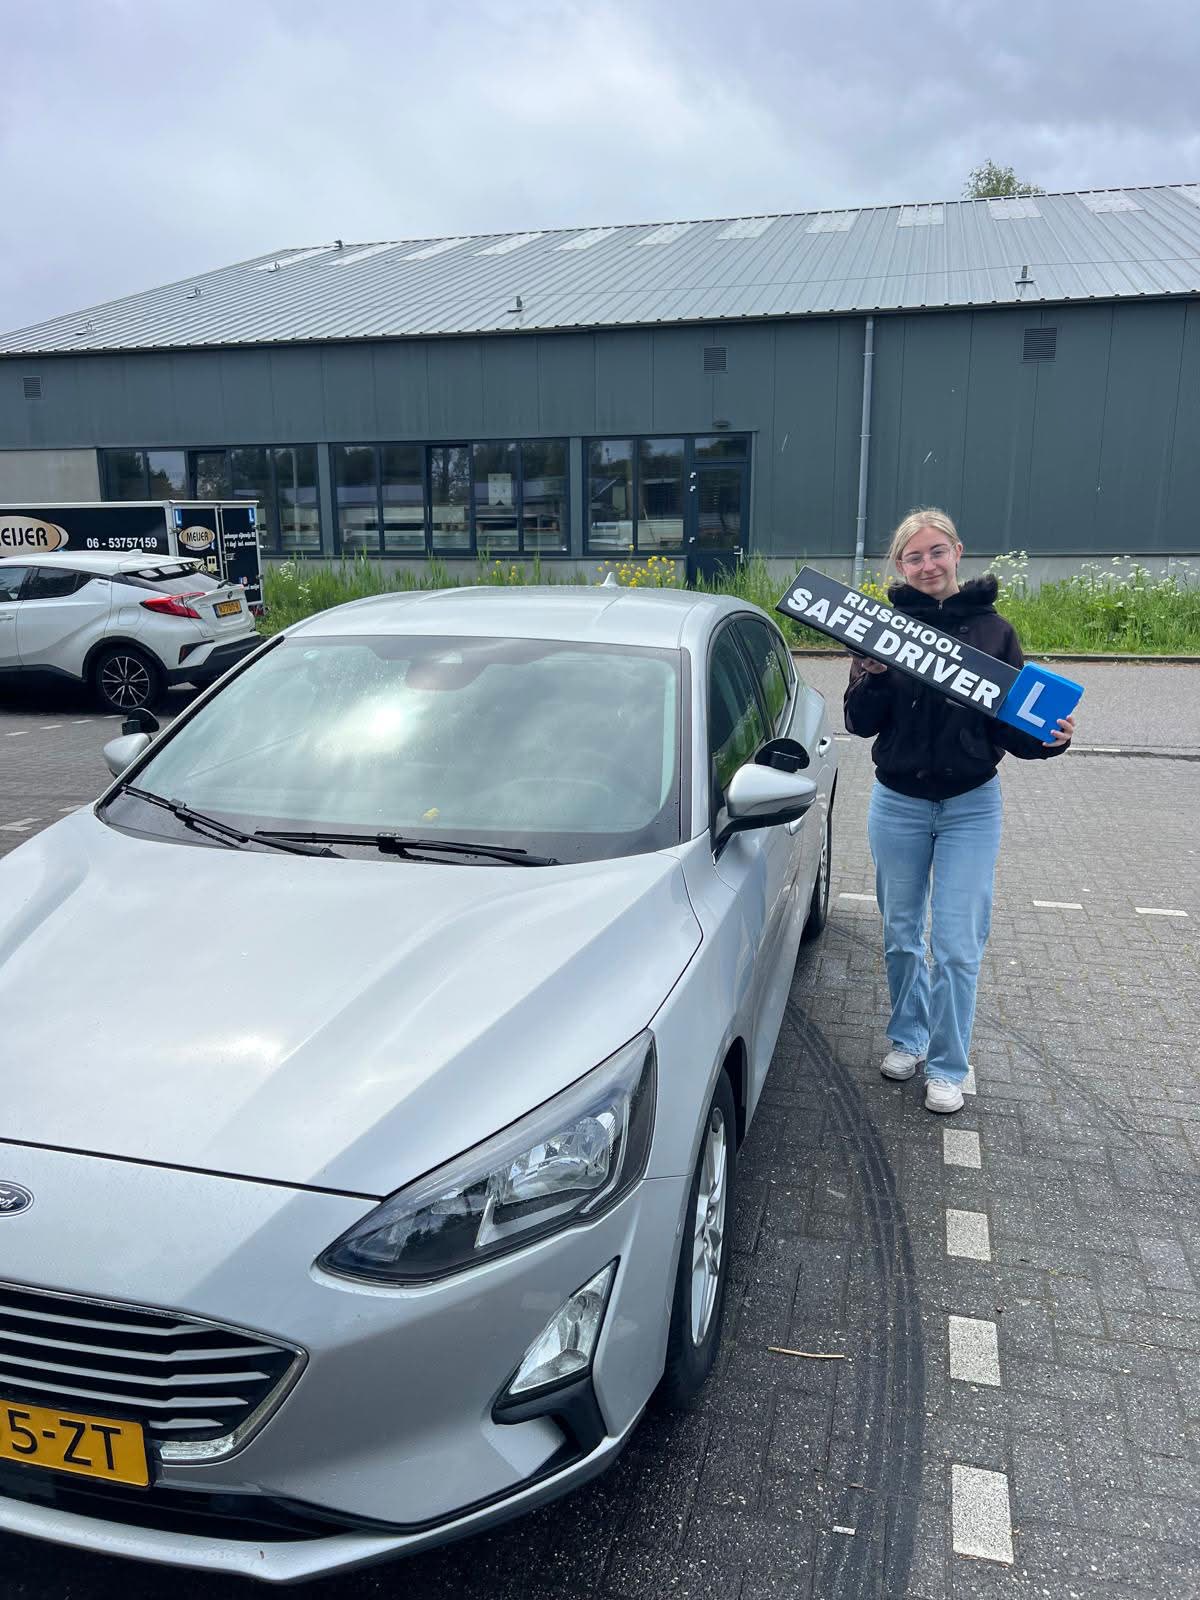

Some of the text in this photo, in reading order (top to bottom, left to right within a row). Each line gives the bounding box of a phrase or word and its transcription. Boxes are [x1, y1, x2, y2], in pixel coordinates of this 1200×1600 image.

[0, 527, 48, 546] EIJER
[86, 537, 100, 549] 06
[108, 537, 158, 548] 53757159
[186, 531, 209, 542] MEIJER
[843, 591, 964, 661] RIJSCHOOL
[787, 587, 1001, 709] SAFE DRIVER
[1016, 680, 1046, 728] L
